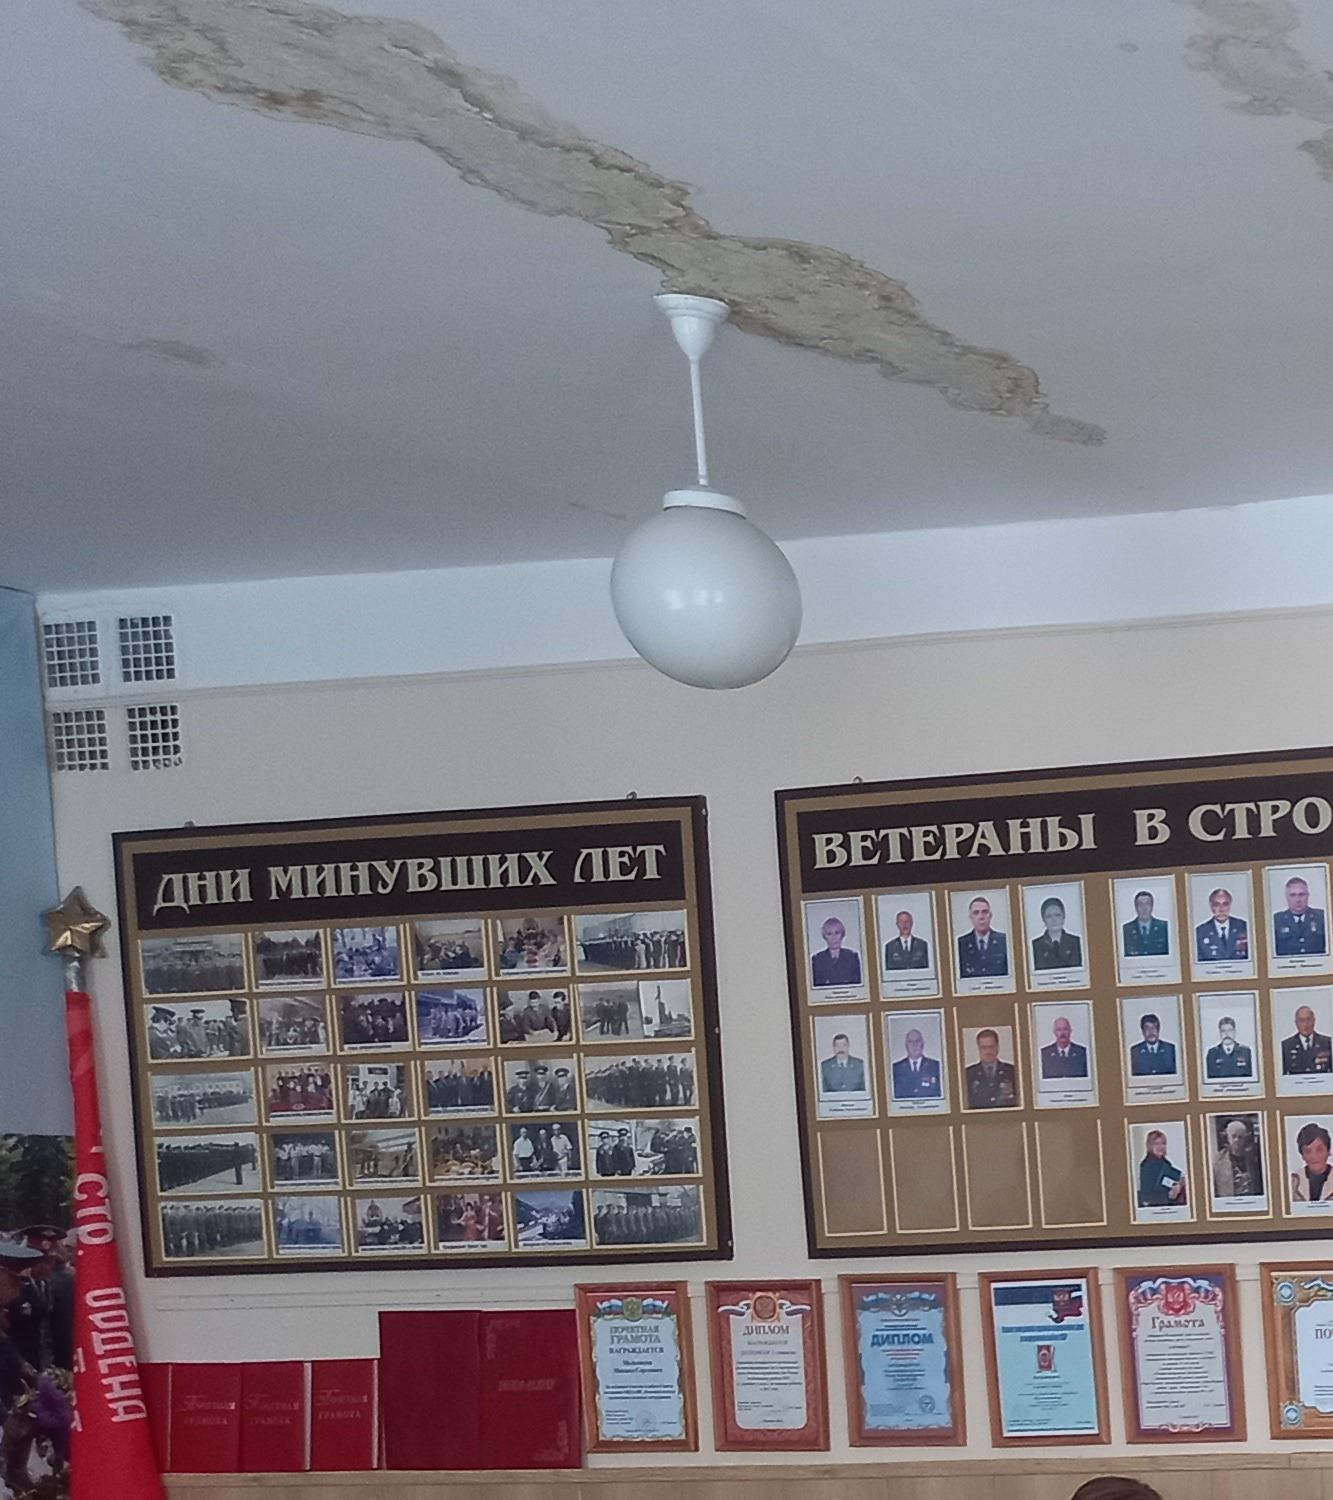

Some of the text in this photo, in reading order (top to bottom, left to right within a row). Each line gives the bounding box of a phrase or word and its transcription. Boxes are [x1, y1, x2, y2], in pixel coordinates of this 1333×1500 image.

[811, 812, 1098, 871] ВЕТЕРАНЫ
[1134, 808, 1171, 847] В
[152, 843, 667, 916] ДНИ МИНУВШИХ ЛЕТ
[742, 1325, 790, 1337] ДИПЛОМ
[1151, 1316, 1205, 1332] Грамота
[609, 1334, 661, 1344] ГРАМОТА
[871, 1332, 935, 1348] ДИПЛОМ
[85, 1286, 149, 1423] ОРДЕНА
